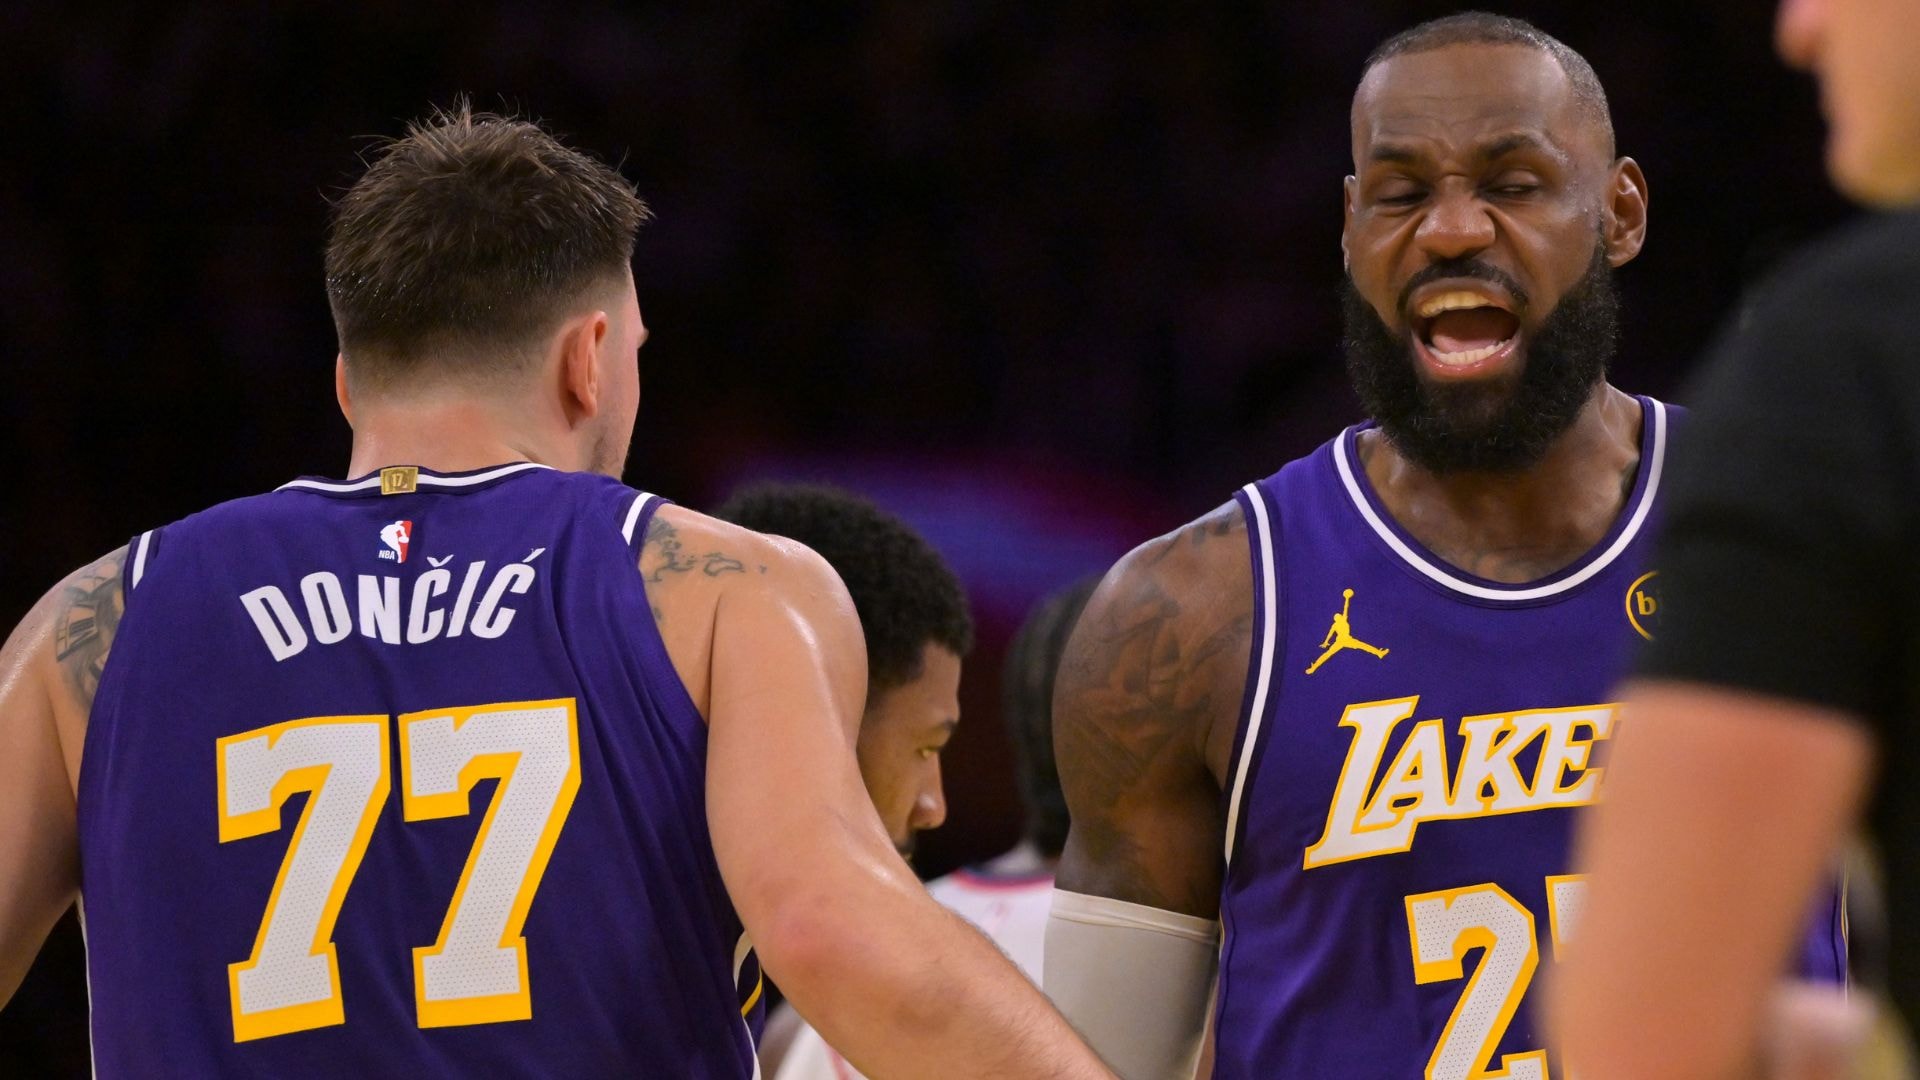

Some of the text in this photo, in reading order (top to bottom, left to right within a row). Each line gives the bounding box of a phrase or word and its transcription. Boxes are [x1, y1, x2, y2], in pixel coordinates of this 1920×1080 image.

[240, 547, 546, 662] DONČIĆ
[378, 549, 396, 560] NBA
[216, 697, 582, 1043] 77
[1303, 695, 1622, 870] LAKE
[1405, 873, 1595, 1080] 2
